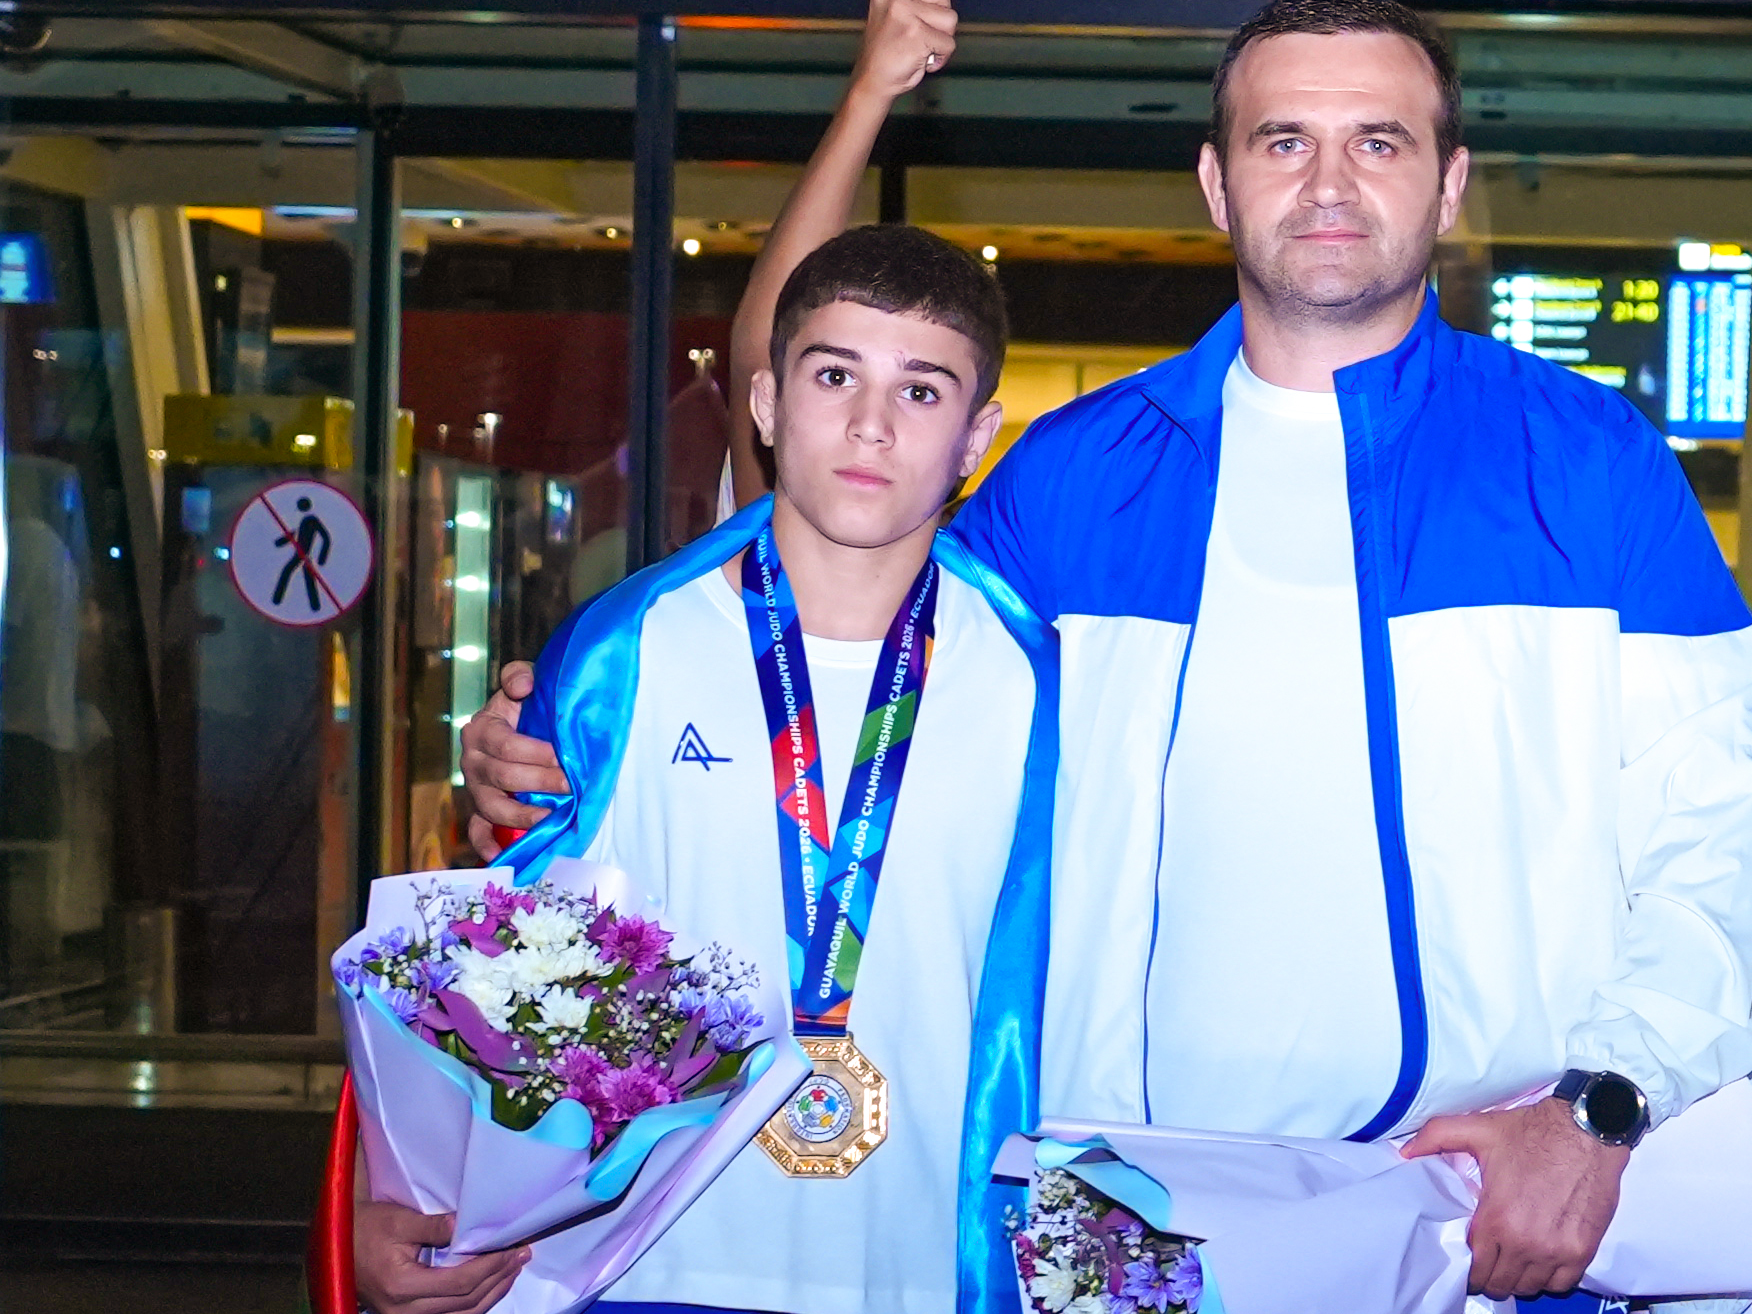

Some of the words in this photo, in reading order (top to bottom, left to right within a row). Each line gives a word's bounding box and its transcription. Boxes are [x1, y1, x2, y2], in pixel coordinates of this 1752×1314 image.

[761, 563, 776, 607] WORLD
[768, 609, 783, 642] JUDO
[774, 643, 804, 754] CHAMPIONSHIPS
[793, 757, 809, 815] CADETS
[819, 917, 848, 999] GUAYAQUIL
[838, 861, 860, 914] WORLD
[852, 819, 870, 859] JUDO
[861, 701, 898, 817] CHAMPIONSHIPS
[889, 651, 911, 703] CADETS
[901, 623, 915, 650] 2026
[798, 819, 813, 854] 2026
